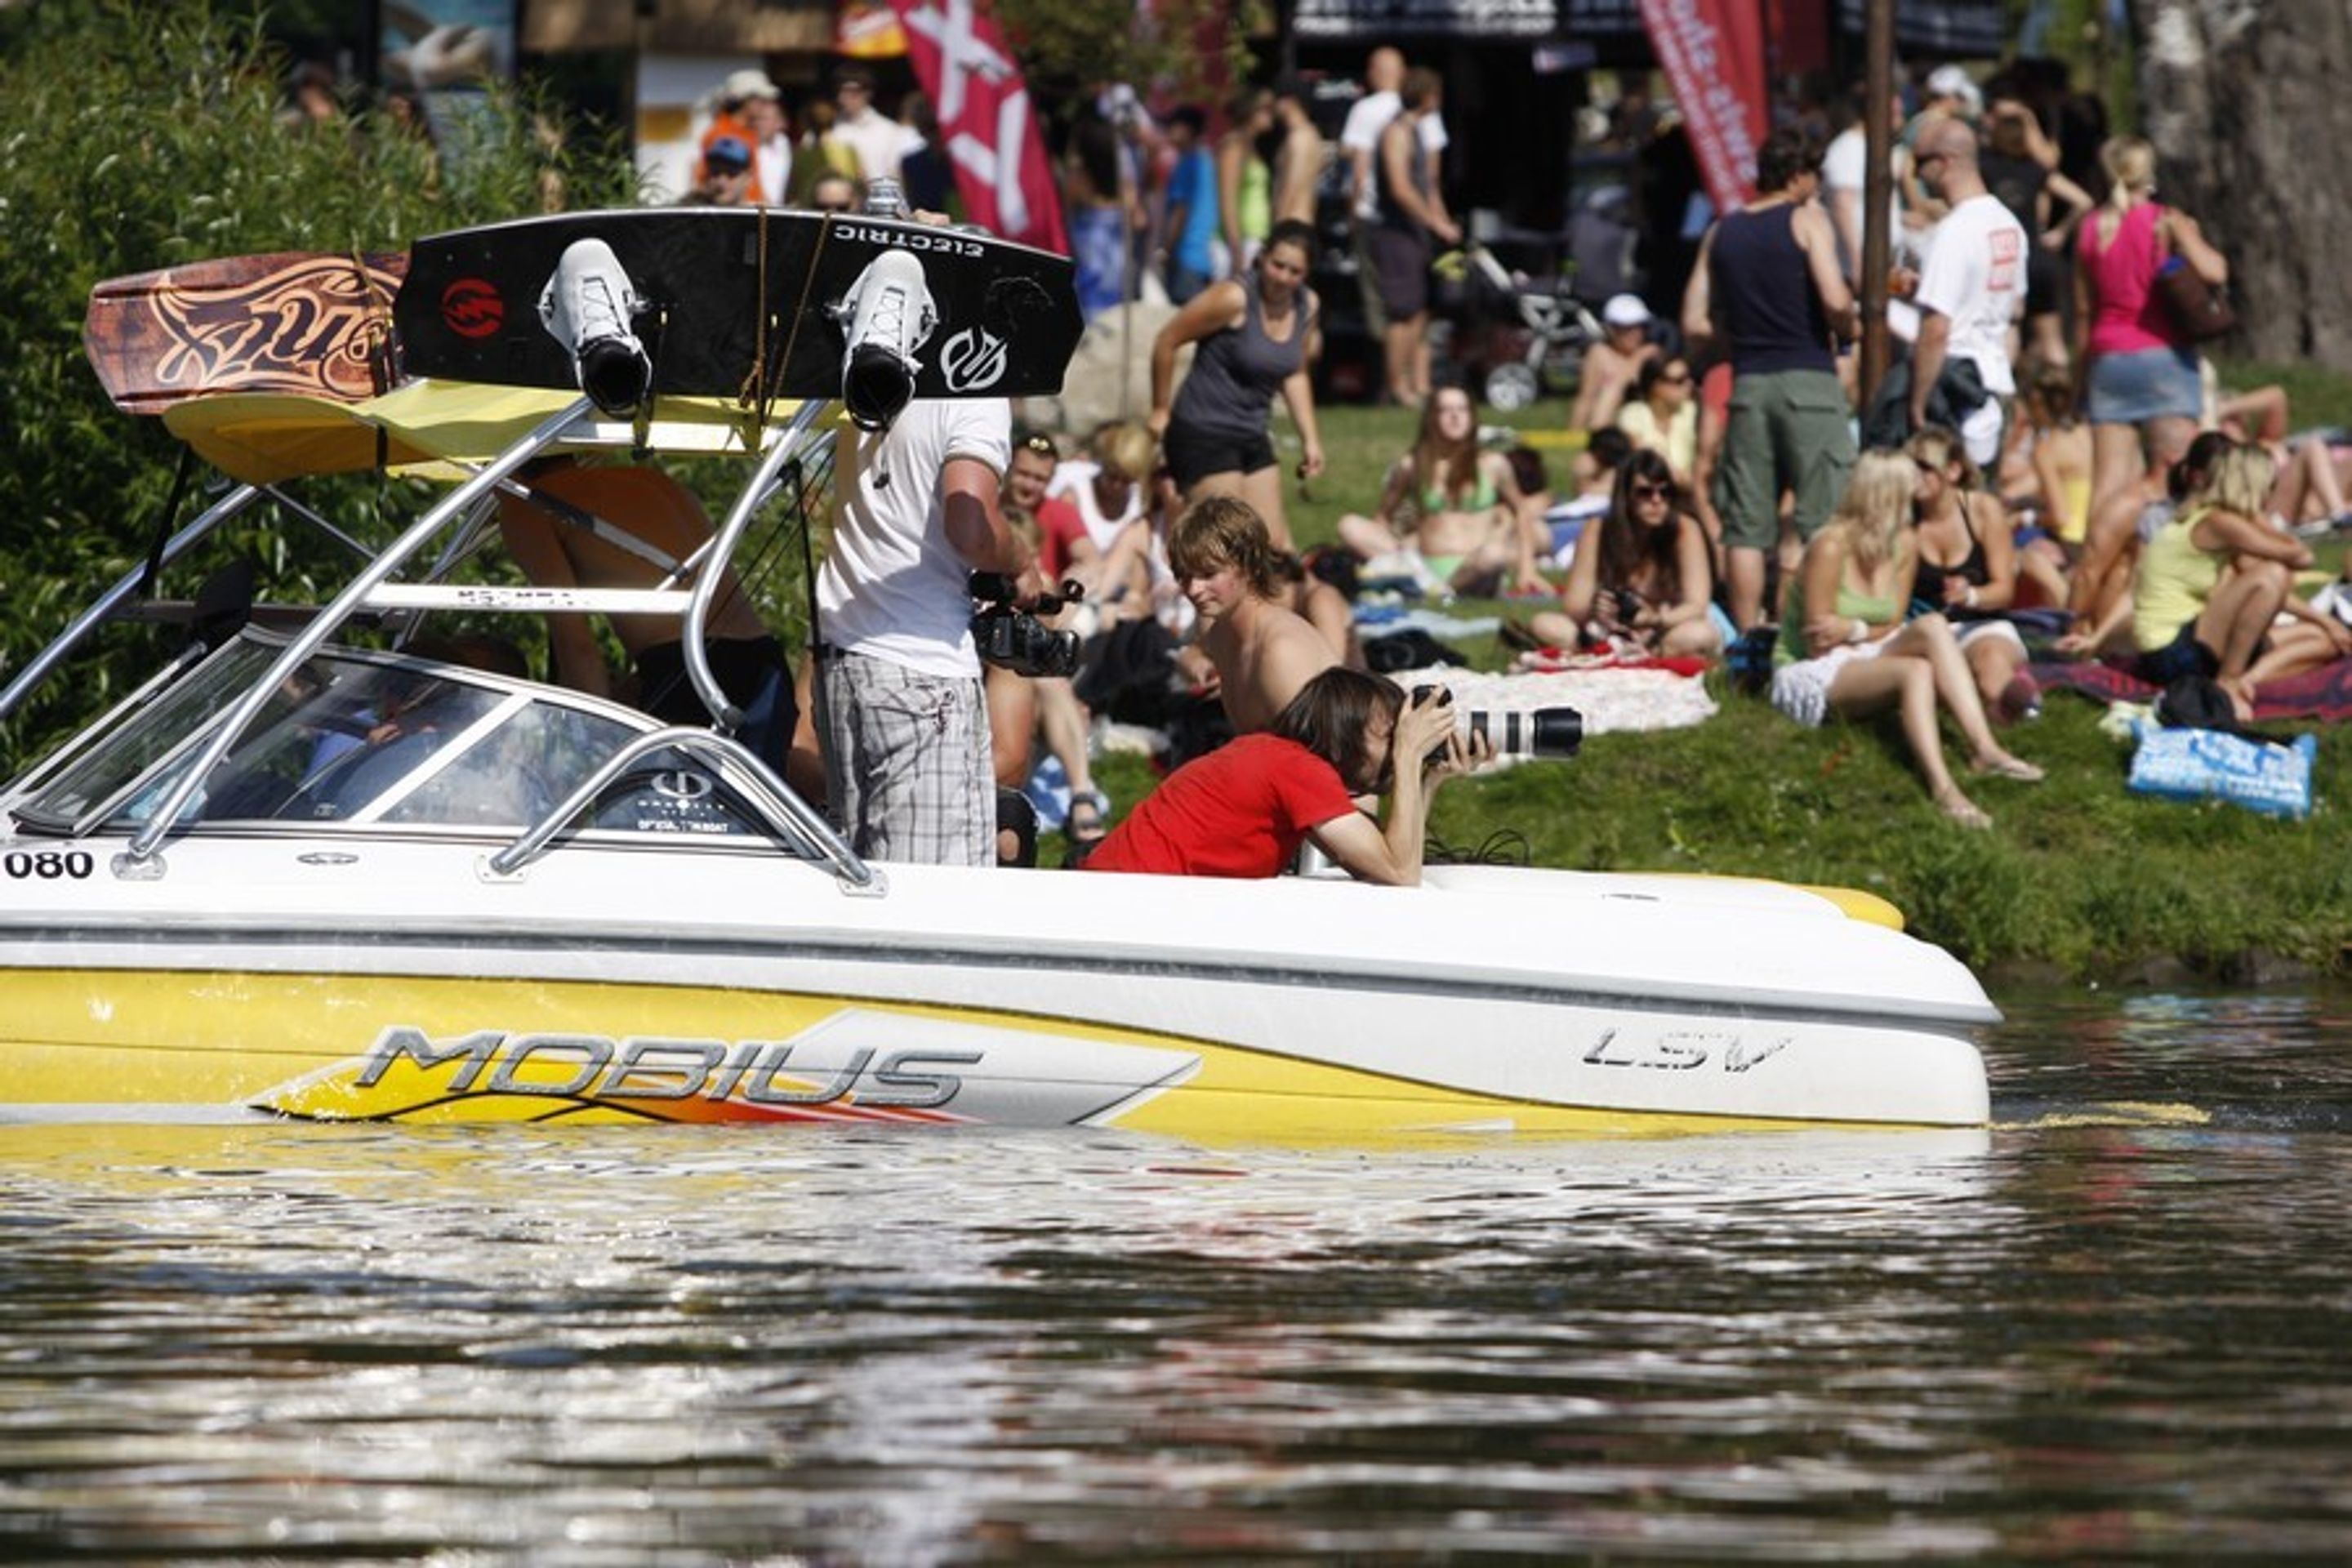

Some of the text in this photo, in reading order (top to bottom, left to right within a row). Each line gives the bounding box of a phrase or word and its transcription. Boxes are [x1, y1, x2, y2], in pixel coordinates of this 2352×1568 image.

[833, 225, 985, 258] ELECTRIC
[4, 852, 94, 880] 080
[353, 1026, 985, 1108] MOBIUS
